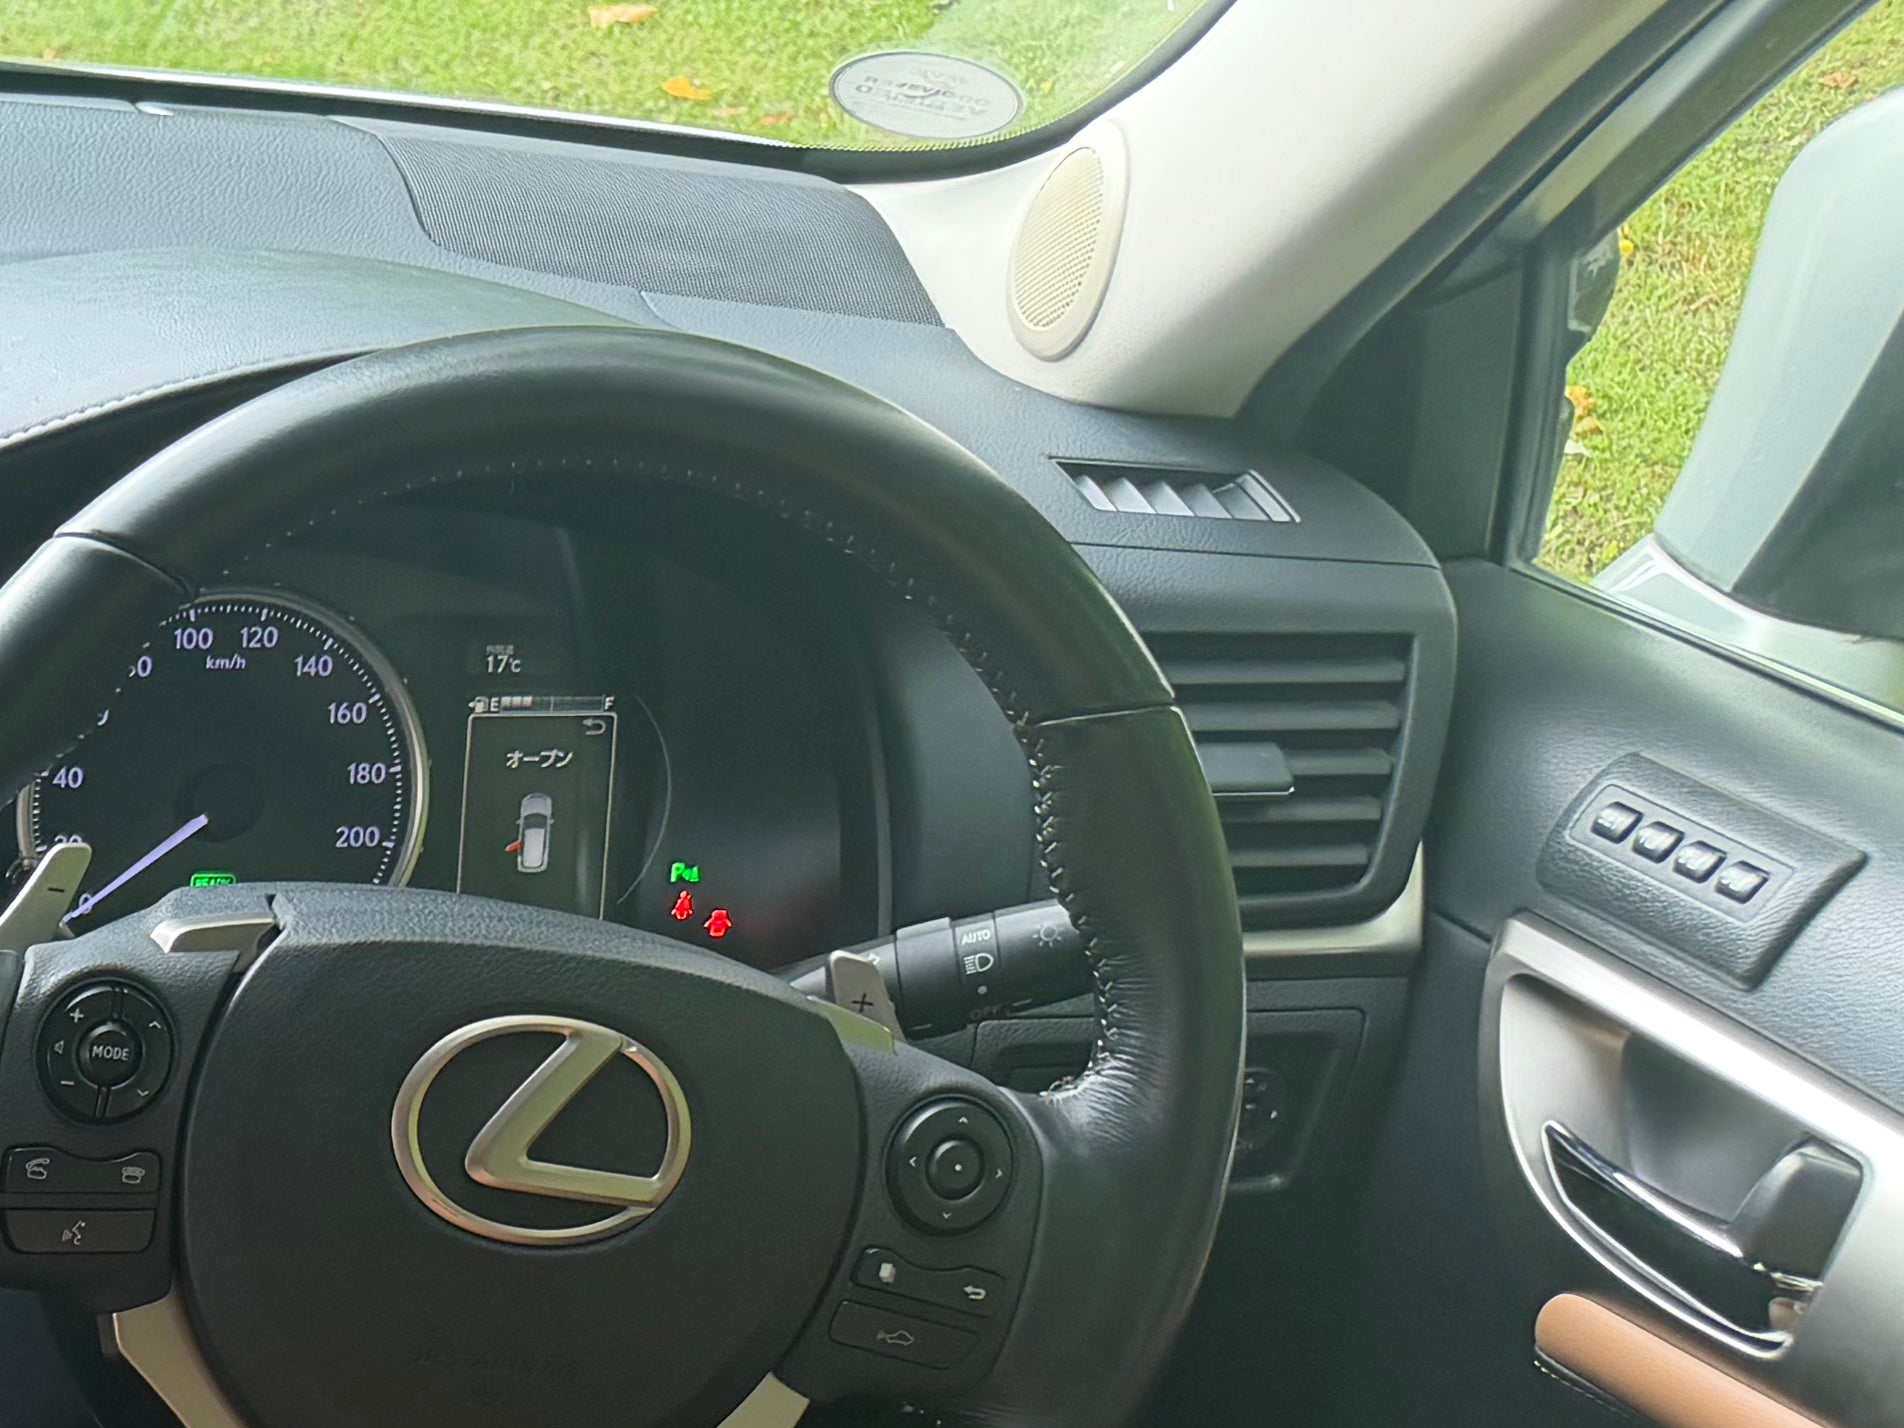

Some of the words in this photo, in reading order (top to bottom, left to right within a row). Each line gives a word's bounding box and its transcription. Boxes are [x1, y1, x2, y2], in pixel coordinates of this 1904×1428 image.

[174, 628, 213, 650] 100
[241, 627, 279, 649] 120
[205, 653, 247, 671] km/h
[294, 655, 334, 677] 140
[328, 702, 367, 724] 160
[490, 697, 500, 711] E
[505, 748, 573, 768] オープン
[52, 766, 84, 789] 40
[347, 762, 386, 784] 180
[335, 826, 380, 848] 200
[961, 929, 991, 945] AUTO
[92, 1045, 130, 1061] MODE
